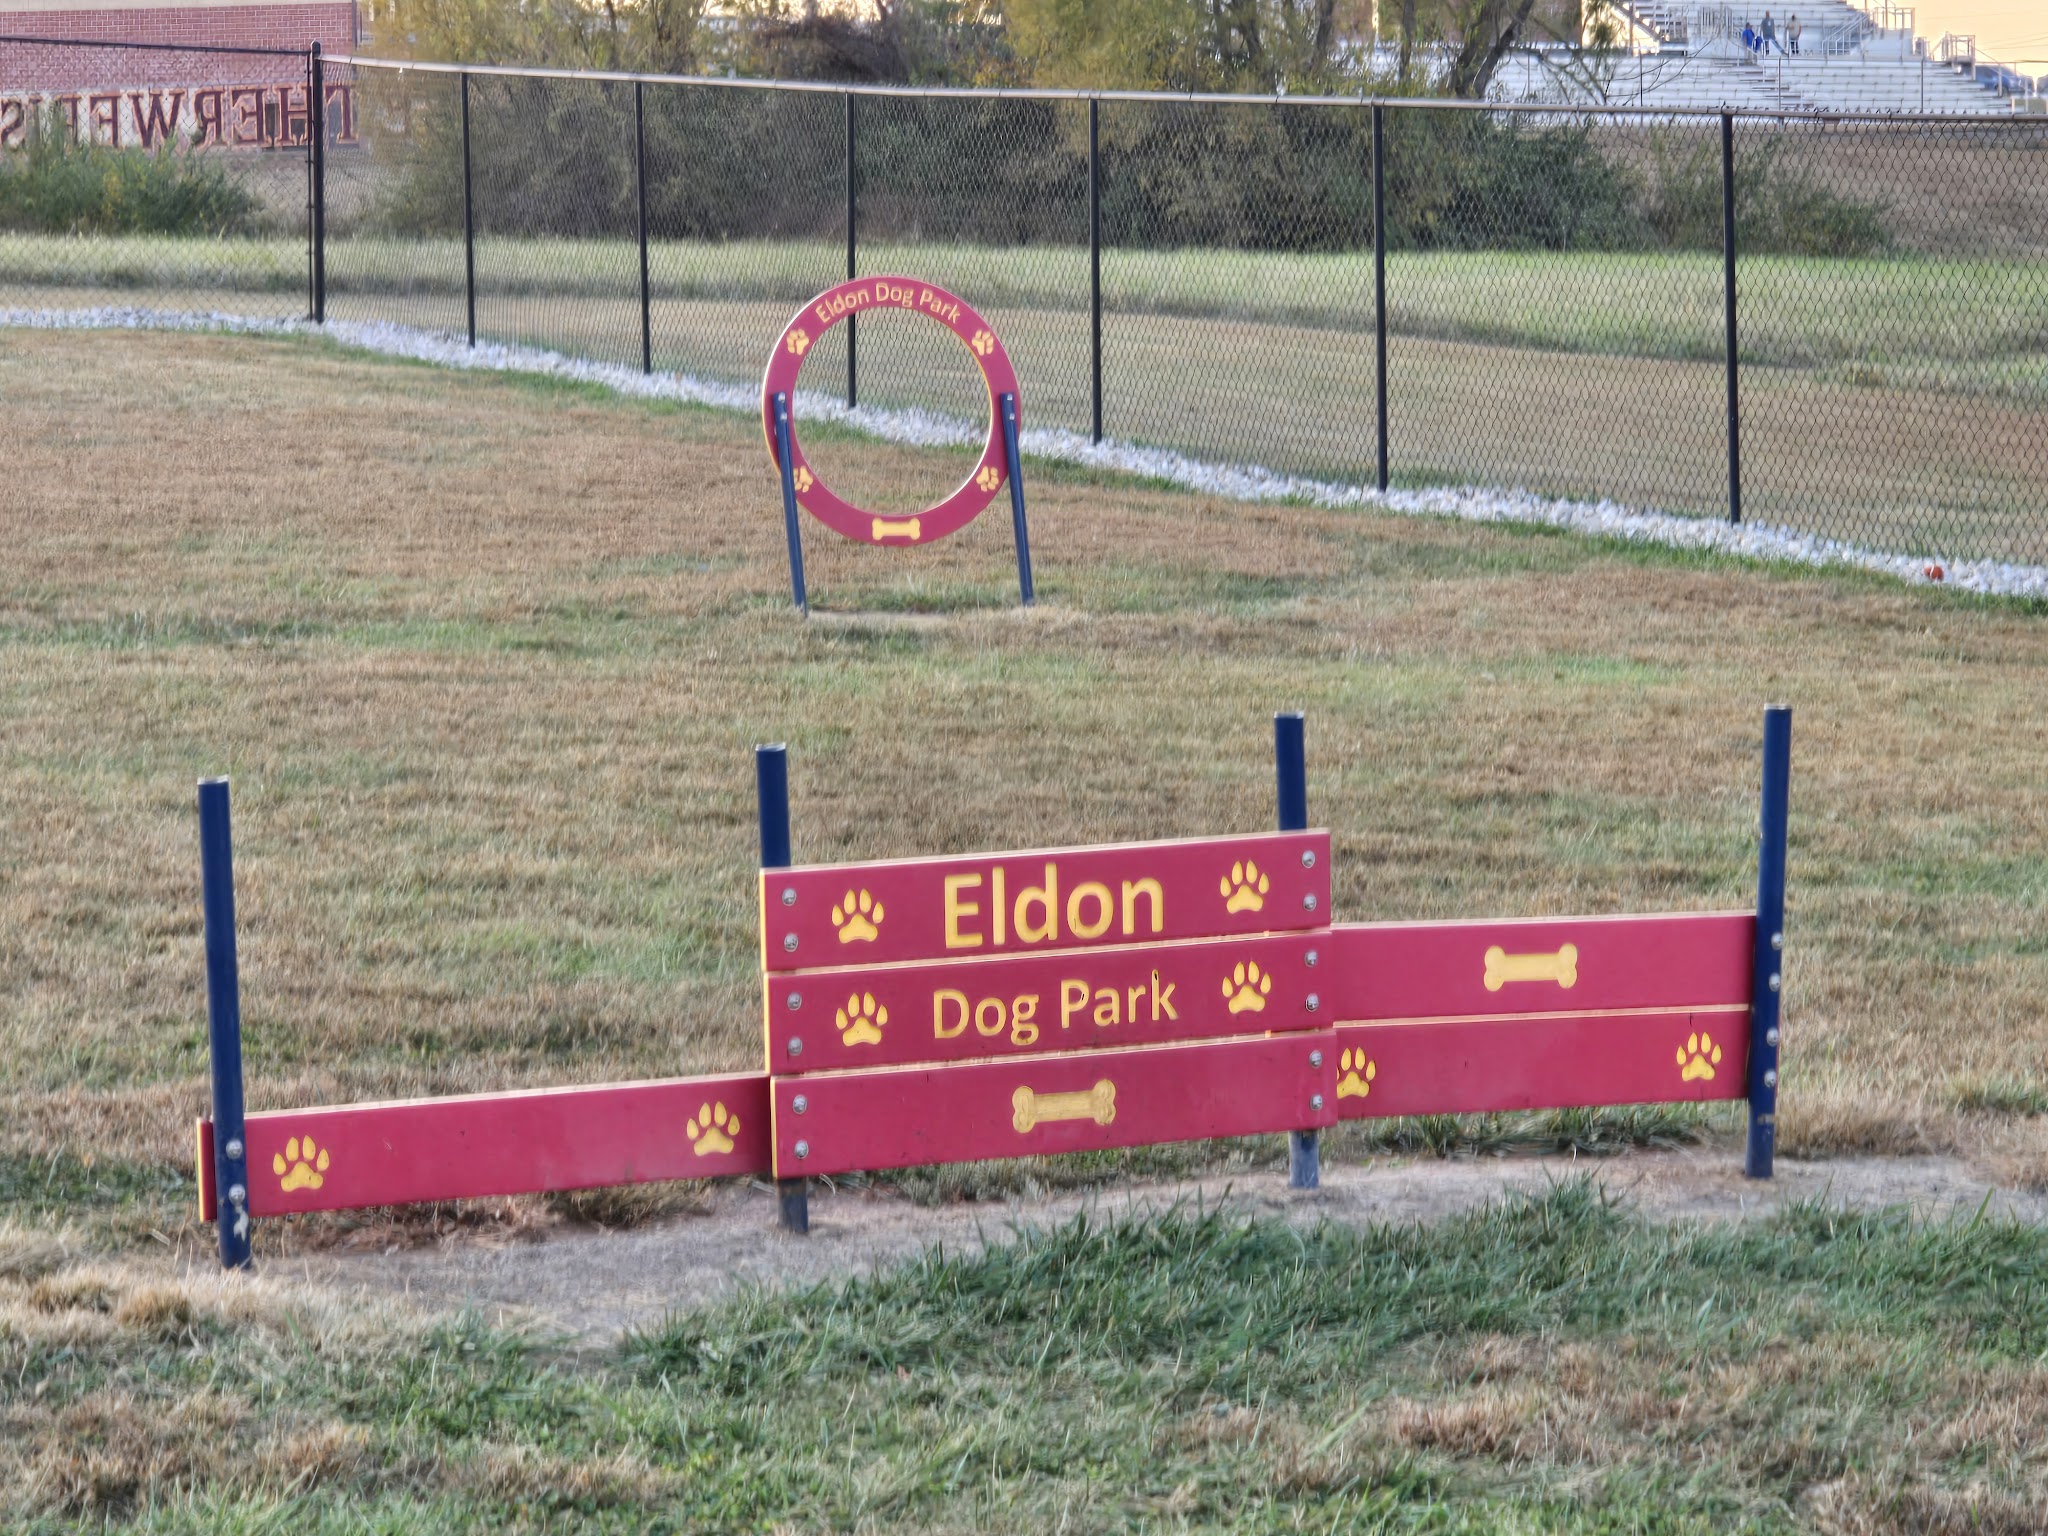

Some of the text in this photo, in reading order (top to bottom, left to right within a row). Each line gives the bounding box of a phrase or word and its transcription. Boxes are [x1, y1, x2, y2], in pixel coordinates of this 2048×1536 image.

[815, 282, 961, 324] Eldon Dog Park
[944, 862, 1164, 949] Eldon
[933, 969, 1179, 1046] Dog Park
